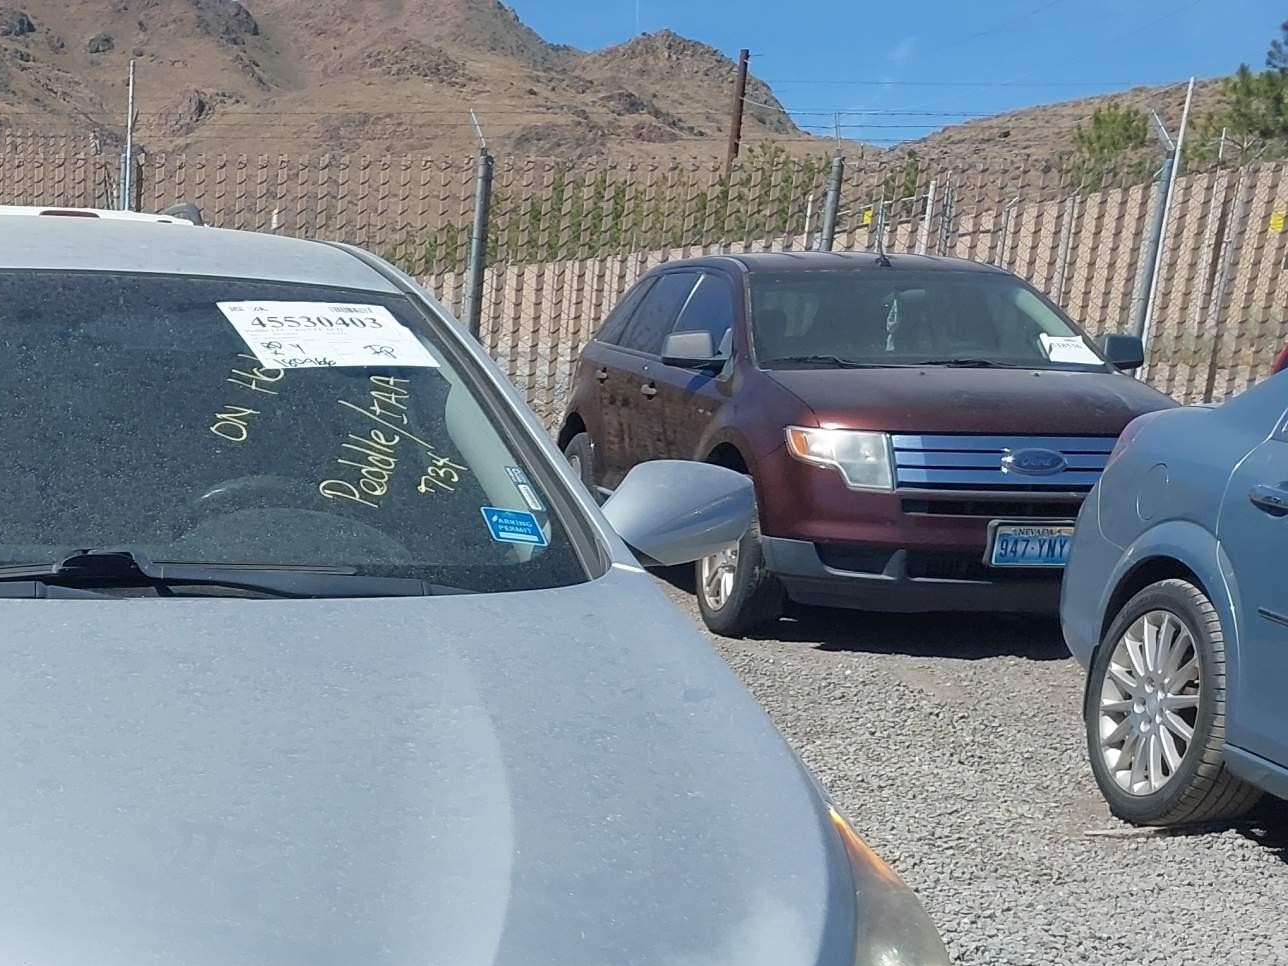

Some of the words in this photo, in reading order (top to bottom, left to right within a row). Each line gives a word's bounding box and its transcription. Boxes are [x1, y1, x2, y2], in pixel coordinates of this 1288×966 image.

[250, 315, 383, 329] 45530403
[210, 405, 261, 441] ON
[498, 524, 532, 534] PERMIT
